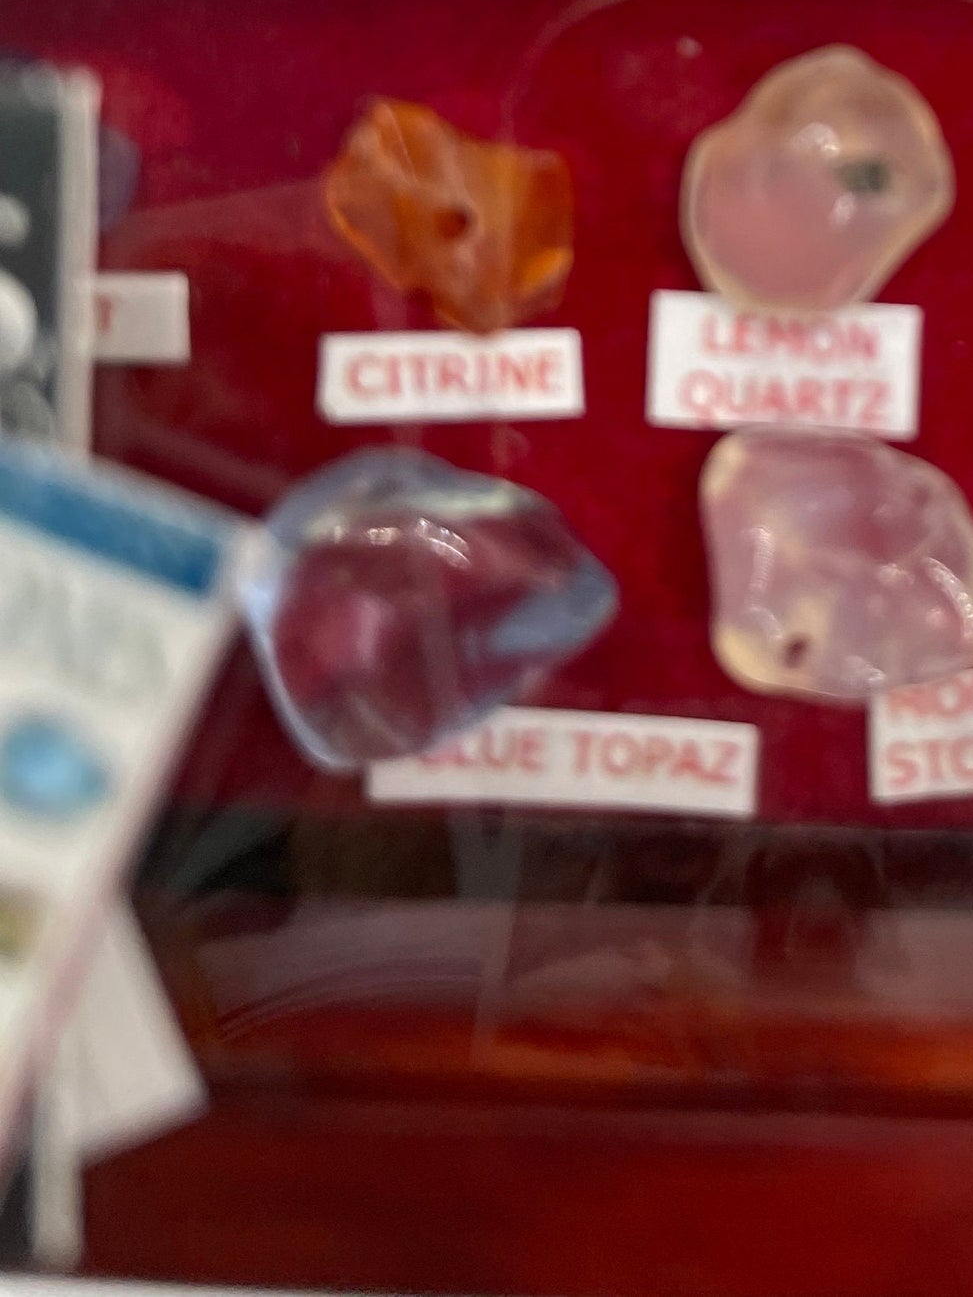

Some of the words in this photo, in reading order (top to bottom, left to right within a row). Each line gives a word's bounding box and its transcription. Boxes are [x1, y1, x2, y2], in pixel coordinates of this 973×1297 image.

[702, 313, 880, 362] LEMON
[346, 350, 562, 400] CITRINE
[677, 368, 891, 425] QUARTZ
[571, 730, 741, 786] TOPAZ
